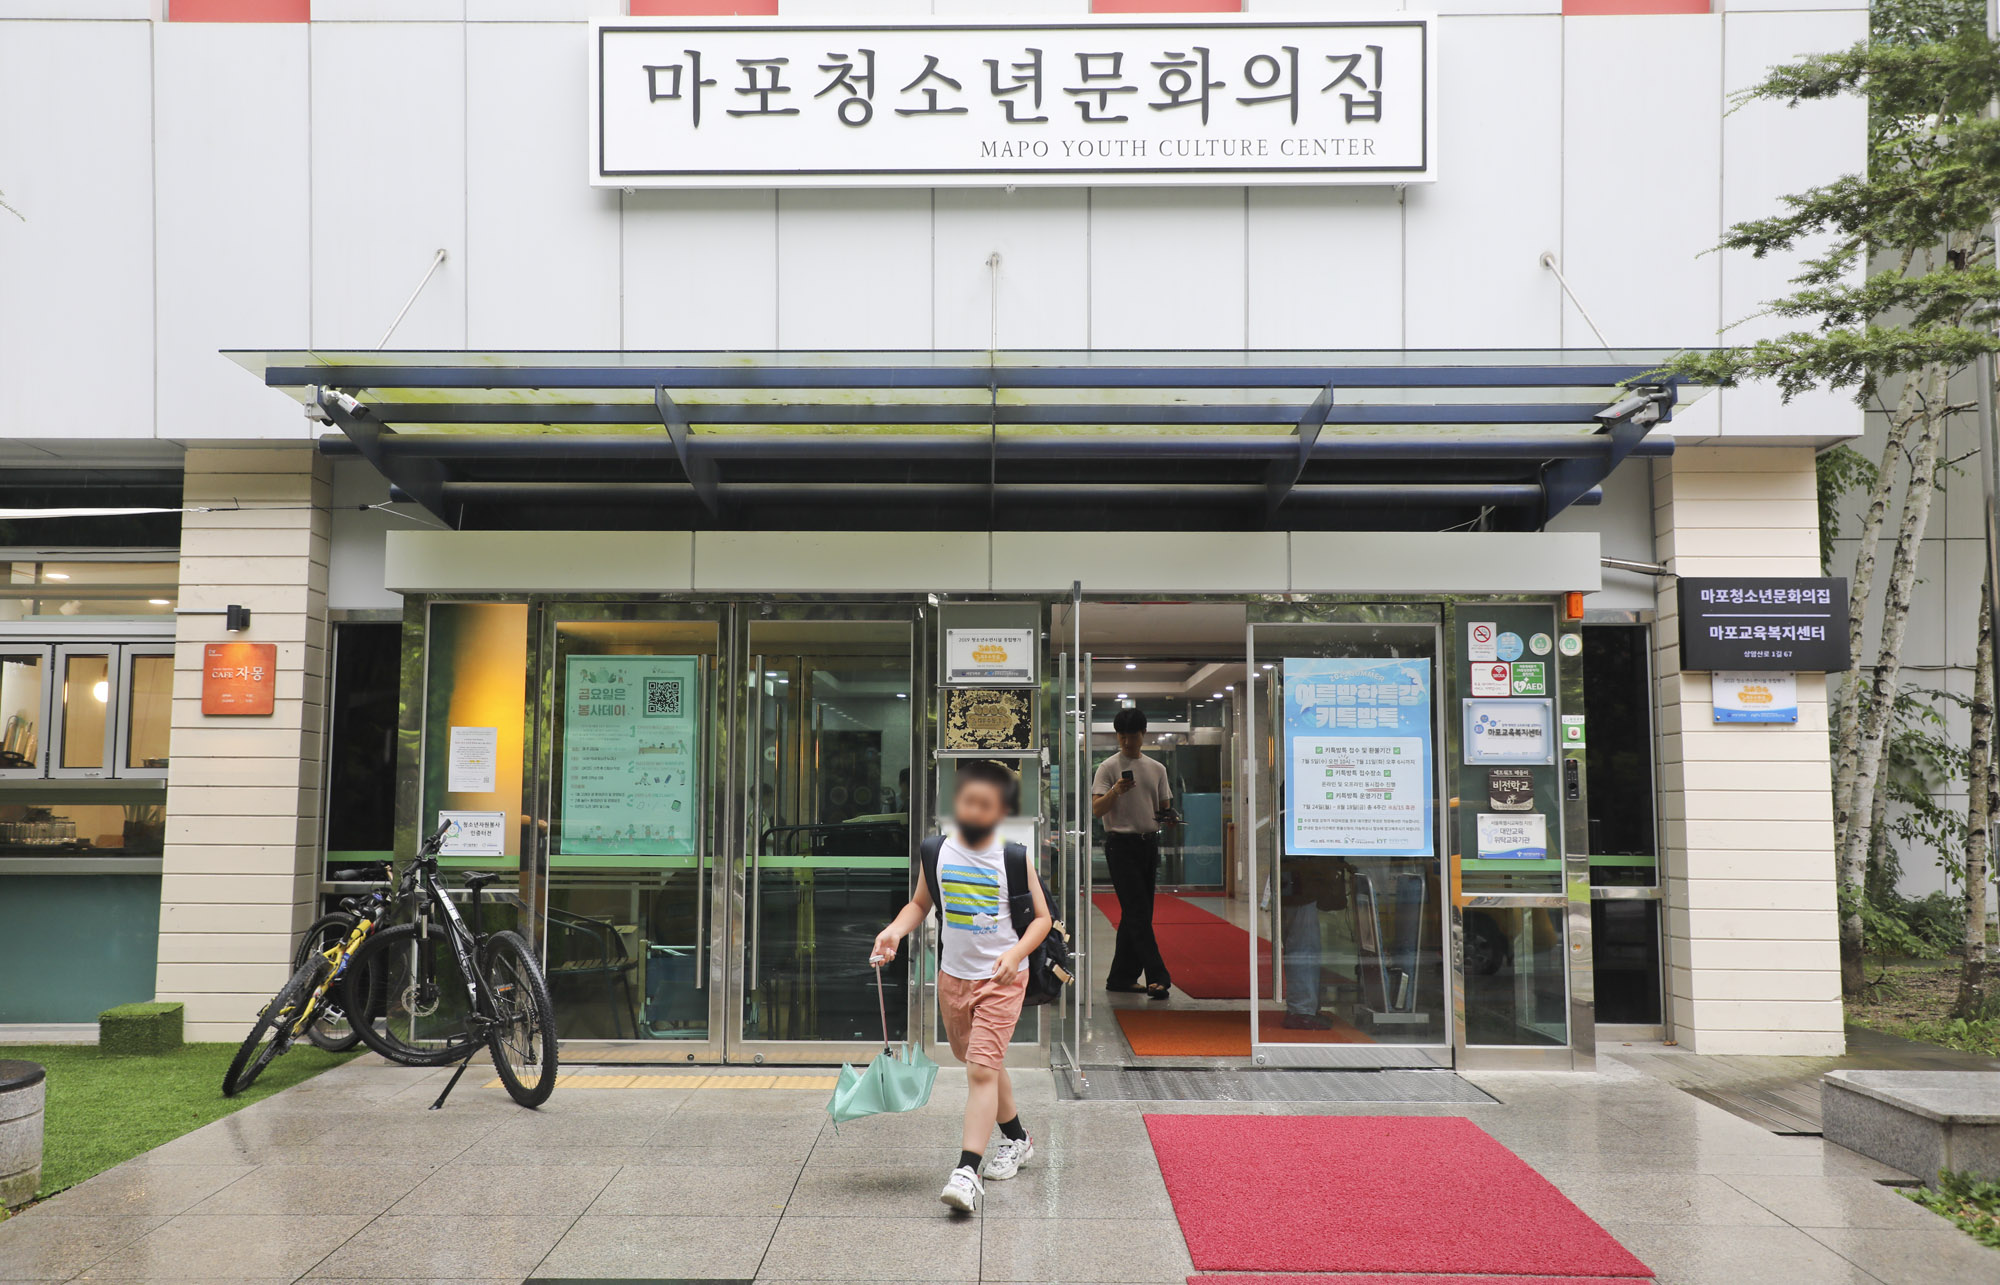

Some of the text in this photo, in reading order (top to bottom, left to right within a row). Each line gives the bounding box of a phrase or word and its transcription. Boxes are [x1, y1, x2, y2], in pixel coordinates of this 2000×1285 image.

[642, 44, 1385, 128] 마포청소년문화의집
[980, 139, 1376, 157] MAPO YOUTH CULTURE CENTER
[1700, 588, 1831, 604] 마포청소년문화의집
[1709, 626, 1826, 641] 마포교육복지센터
[236, 666, 264, 681] 자몽
[578, 704, 626, 717] 봉사데이
[1488, 728, 1542, 738] 마포교육복지센터
[1492, 780, 1530, 792] 비전학교
